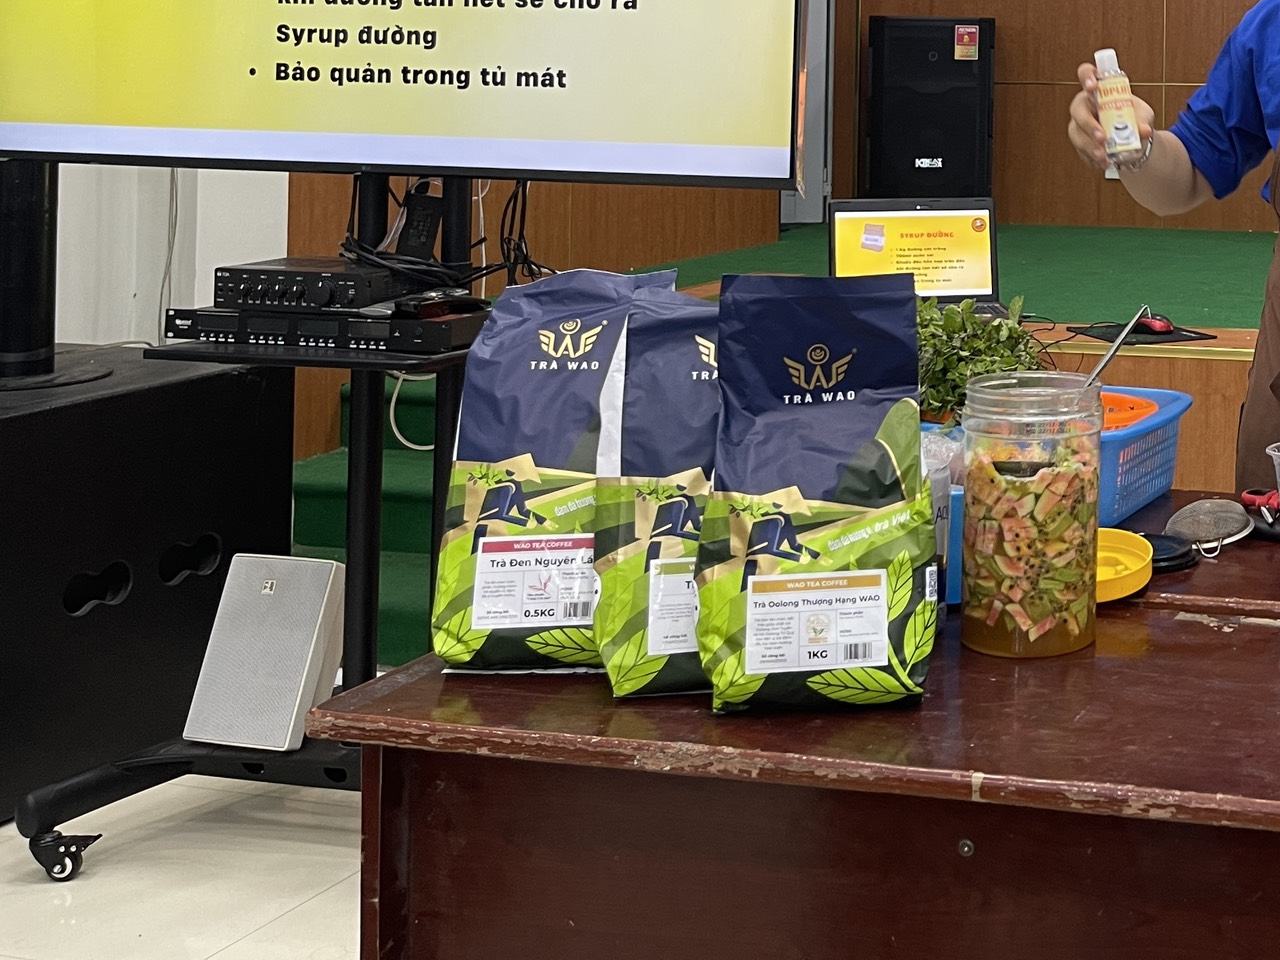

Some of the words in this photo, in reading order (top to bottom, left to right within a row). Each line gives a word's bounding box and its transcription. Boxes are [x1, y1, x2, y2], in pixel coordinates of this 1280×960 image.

[276, 24, 349, 47] Syrup
[358, 25, 438, 50] đường
[275, 62, 321, 82] Bảo
[330, 62, 392, 86] quản
[401, 65, 470, 90] trong
[480, 65, 506, 87] tủ
[516, 67, 567, 88] mát
[530, 359, 557, 370] TRÀ
[567, 361, 599, 370] WAO
[783, 392, 813, 404] TRÀ
[822, 390, 856, 403] WAO
[546, 540, 573, 548] COFFEE
[490, 558, 506, 568] Trà
[509, 558, 532, 567] Đen
[787, 581, 805, 589] WAO
[821, 578, 848, 587] COFFEE
[753, 600, 766, 609] Trà
[768, 599, 799, 609] Oolong
[835, 596, 857, 606] Hạng
[859, 594, 880, 602] WAO
[524, 608, 555, 618] 0.5KG
[807, 650, 828, 659] 1KG
